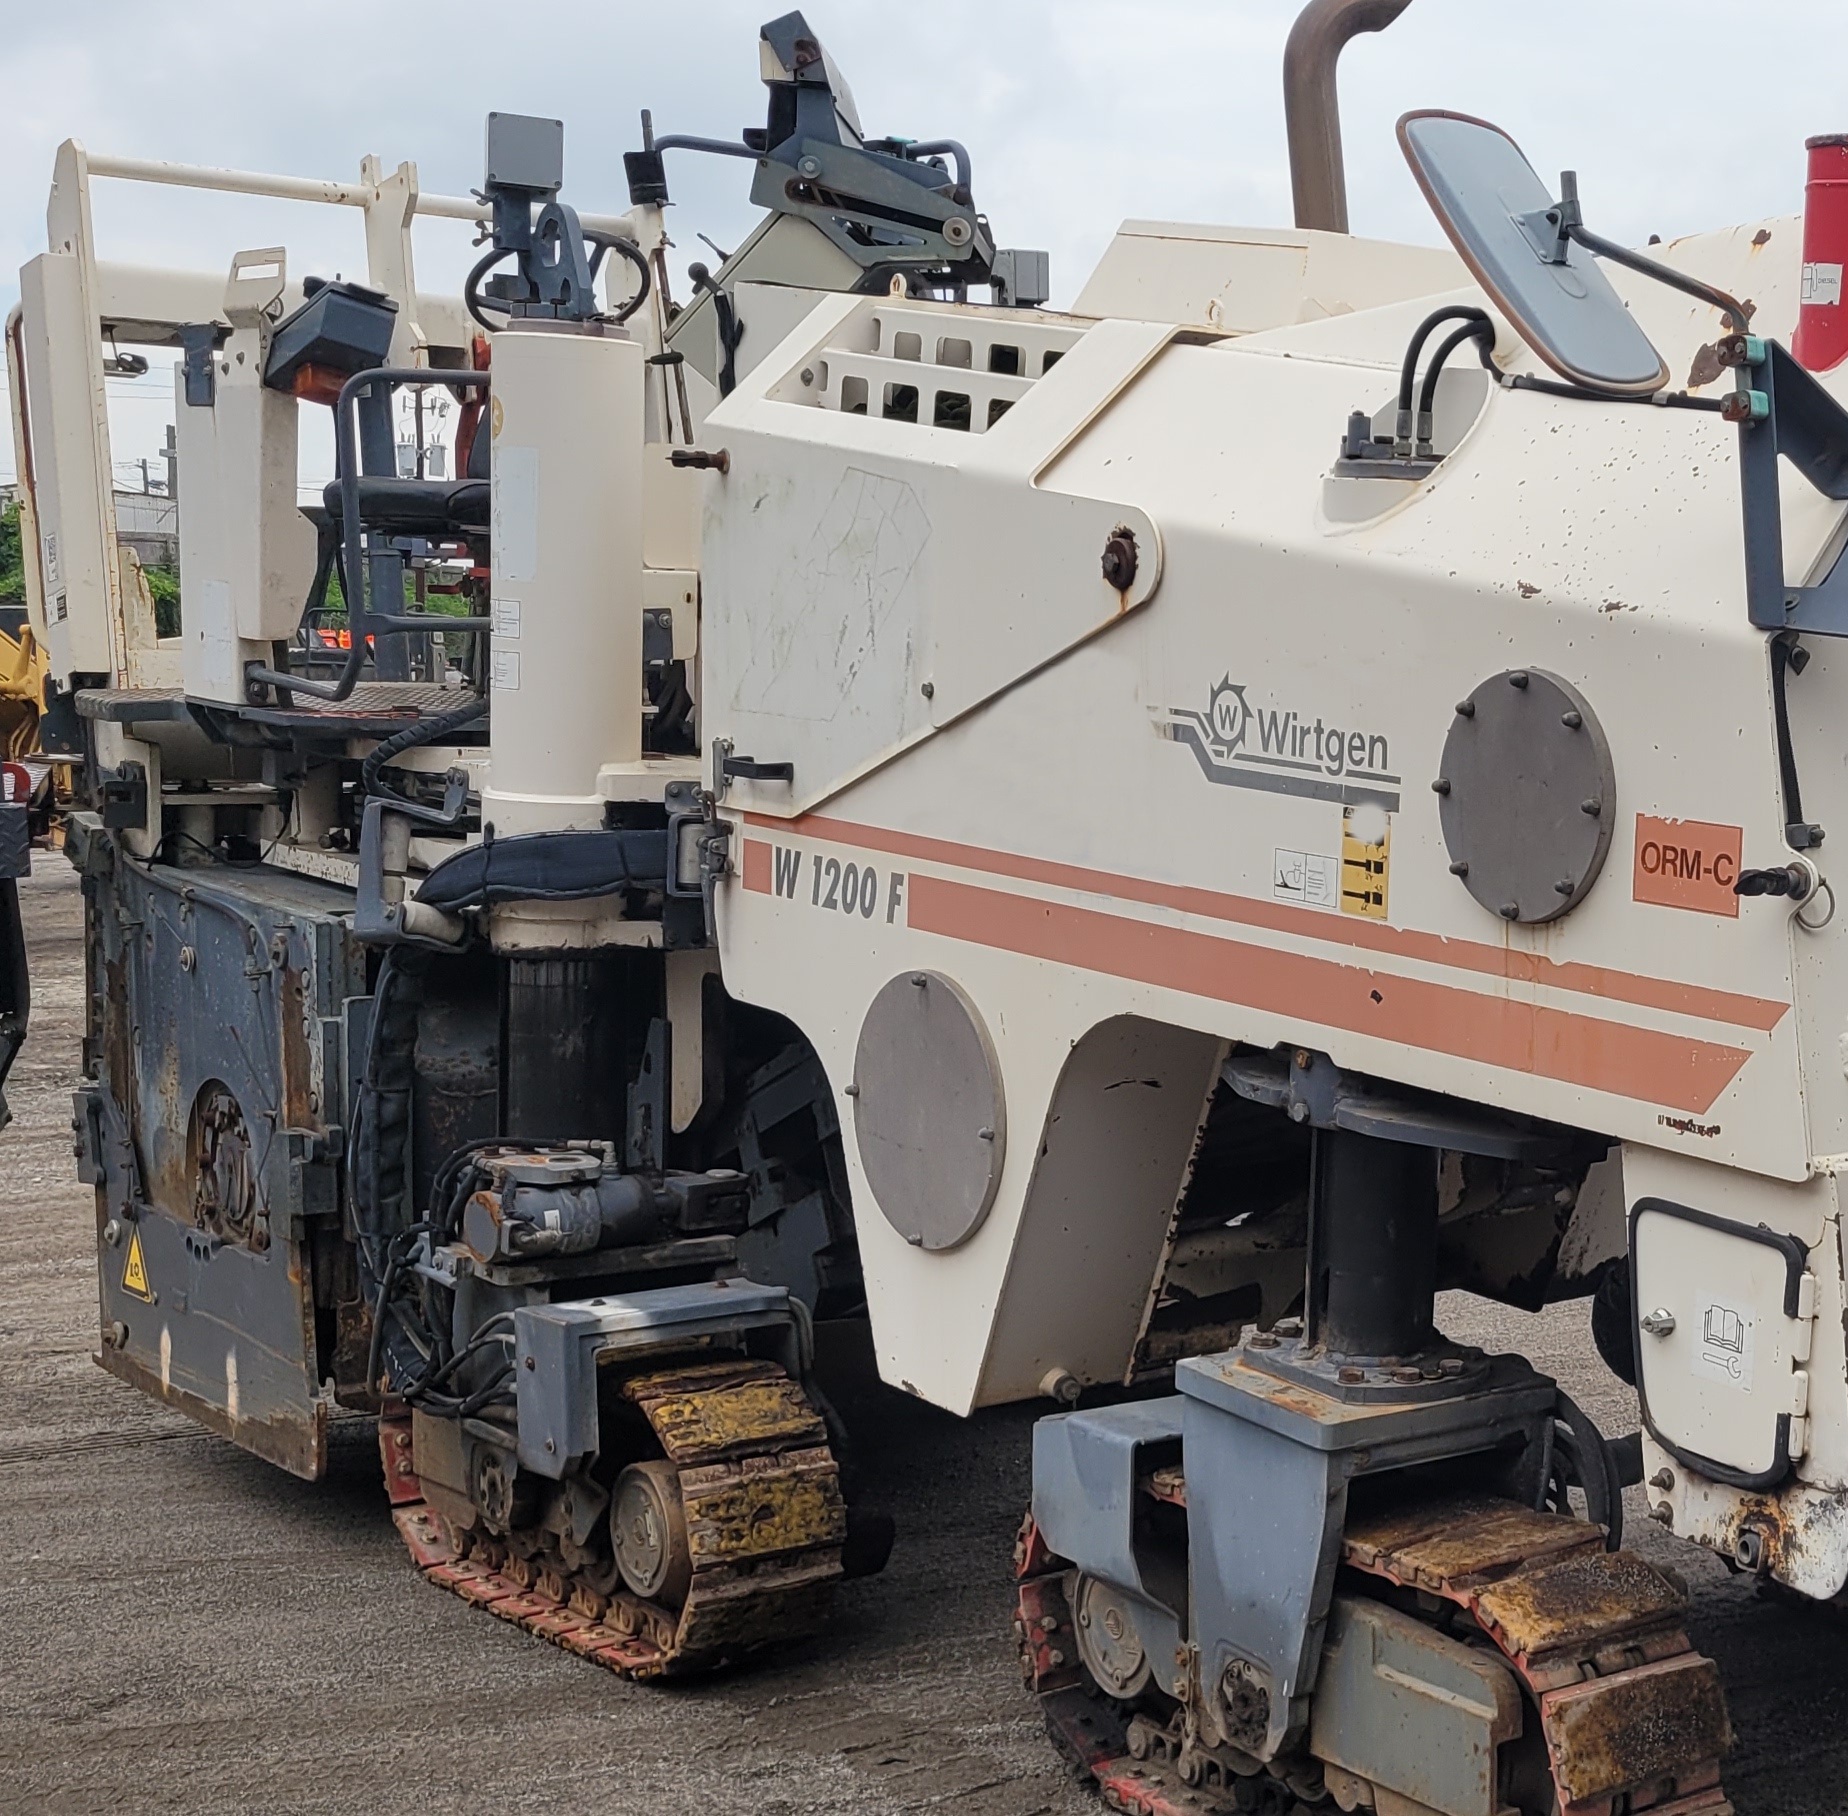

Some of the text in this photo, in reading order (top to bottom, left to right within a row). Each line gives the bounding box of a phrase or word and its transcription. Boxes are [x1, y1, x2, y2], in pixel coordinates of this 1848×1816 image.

[1257, 708, 1388, 776] Wirtgen
[775, 845, 904, 924] W 1200 F
[1641, 841, 1734, 887] ORM-C
